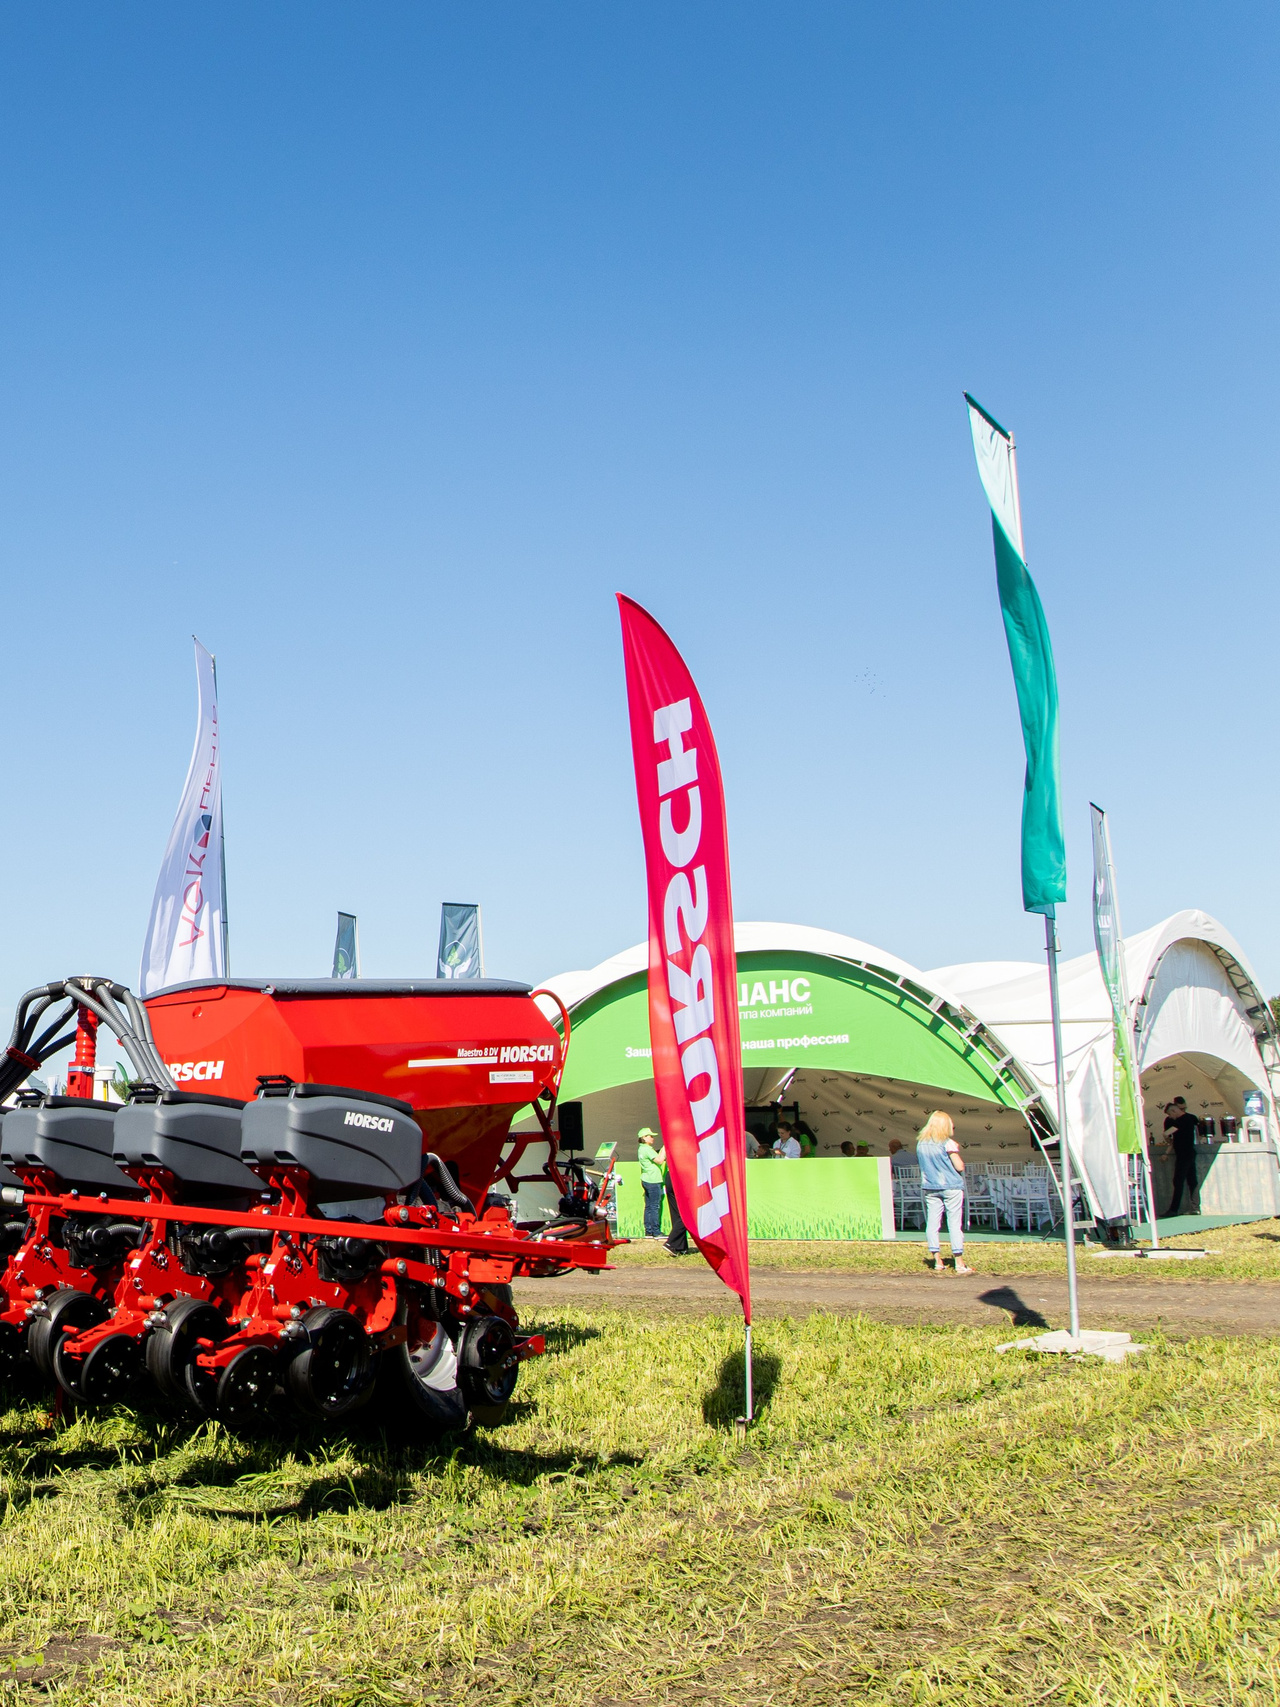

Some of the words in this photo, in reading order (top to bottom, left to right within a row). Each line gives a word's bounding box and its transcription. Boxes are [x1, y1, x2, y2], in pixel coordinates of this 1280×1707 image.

[760, 1003, 813, 1019] компаний
[742, 1040, 775, 1050] наша
[777, 1034, 850, 1050] профессия
[457, 1048, 483, 1058] Maestro
[484, 1047, 489, 1057] 8
[489, 1047, 499, 1056] DV
[500, 1045, 554, 1064] HORSCH
[164, 1060, 225, 1082] RSCH
[344, 1111, 394, 1133] HORSCH
